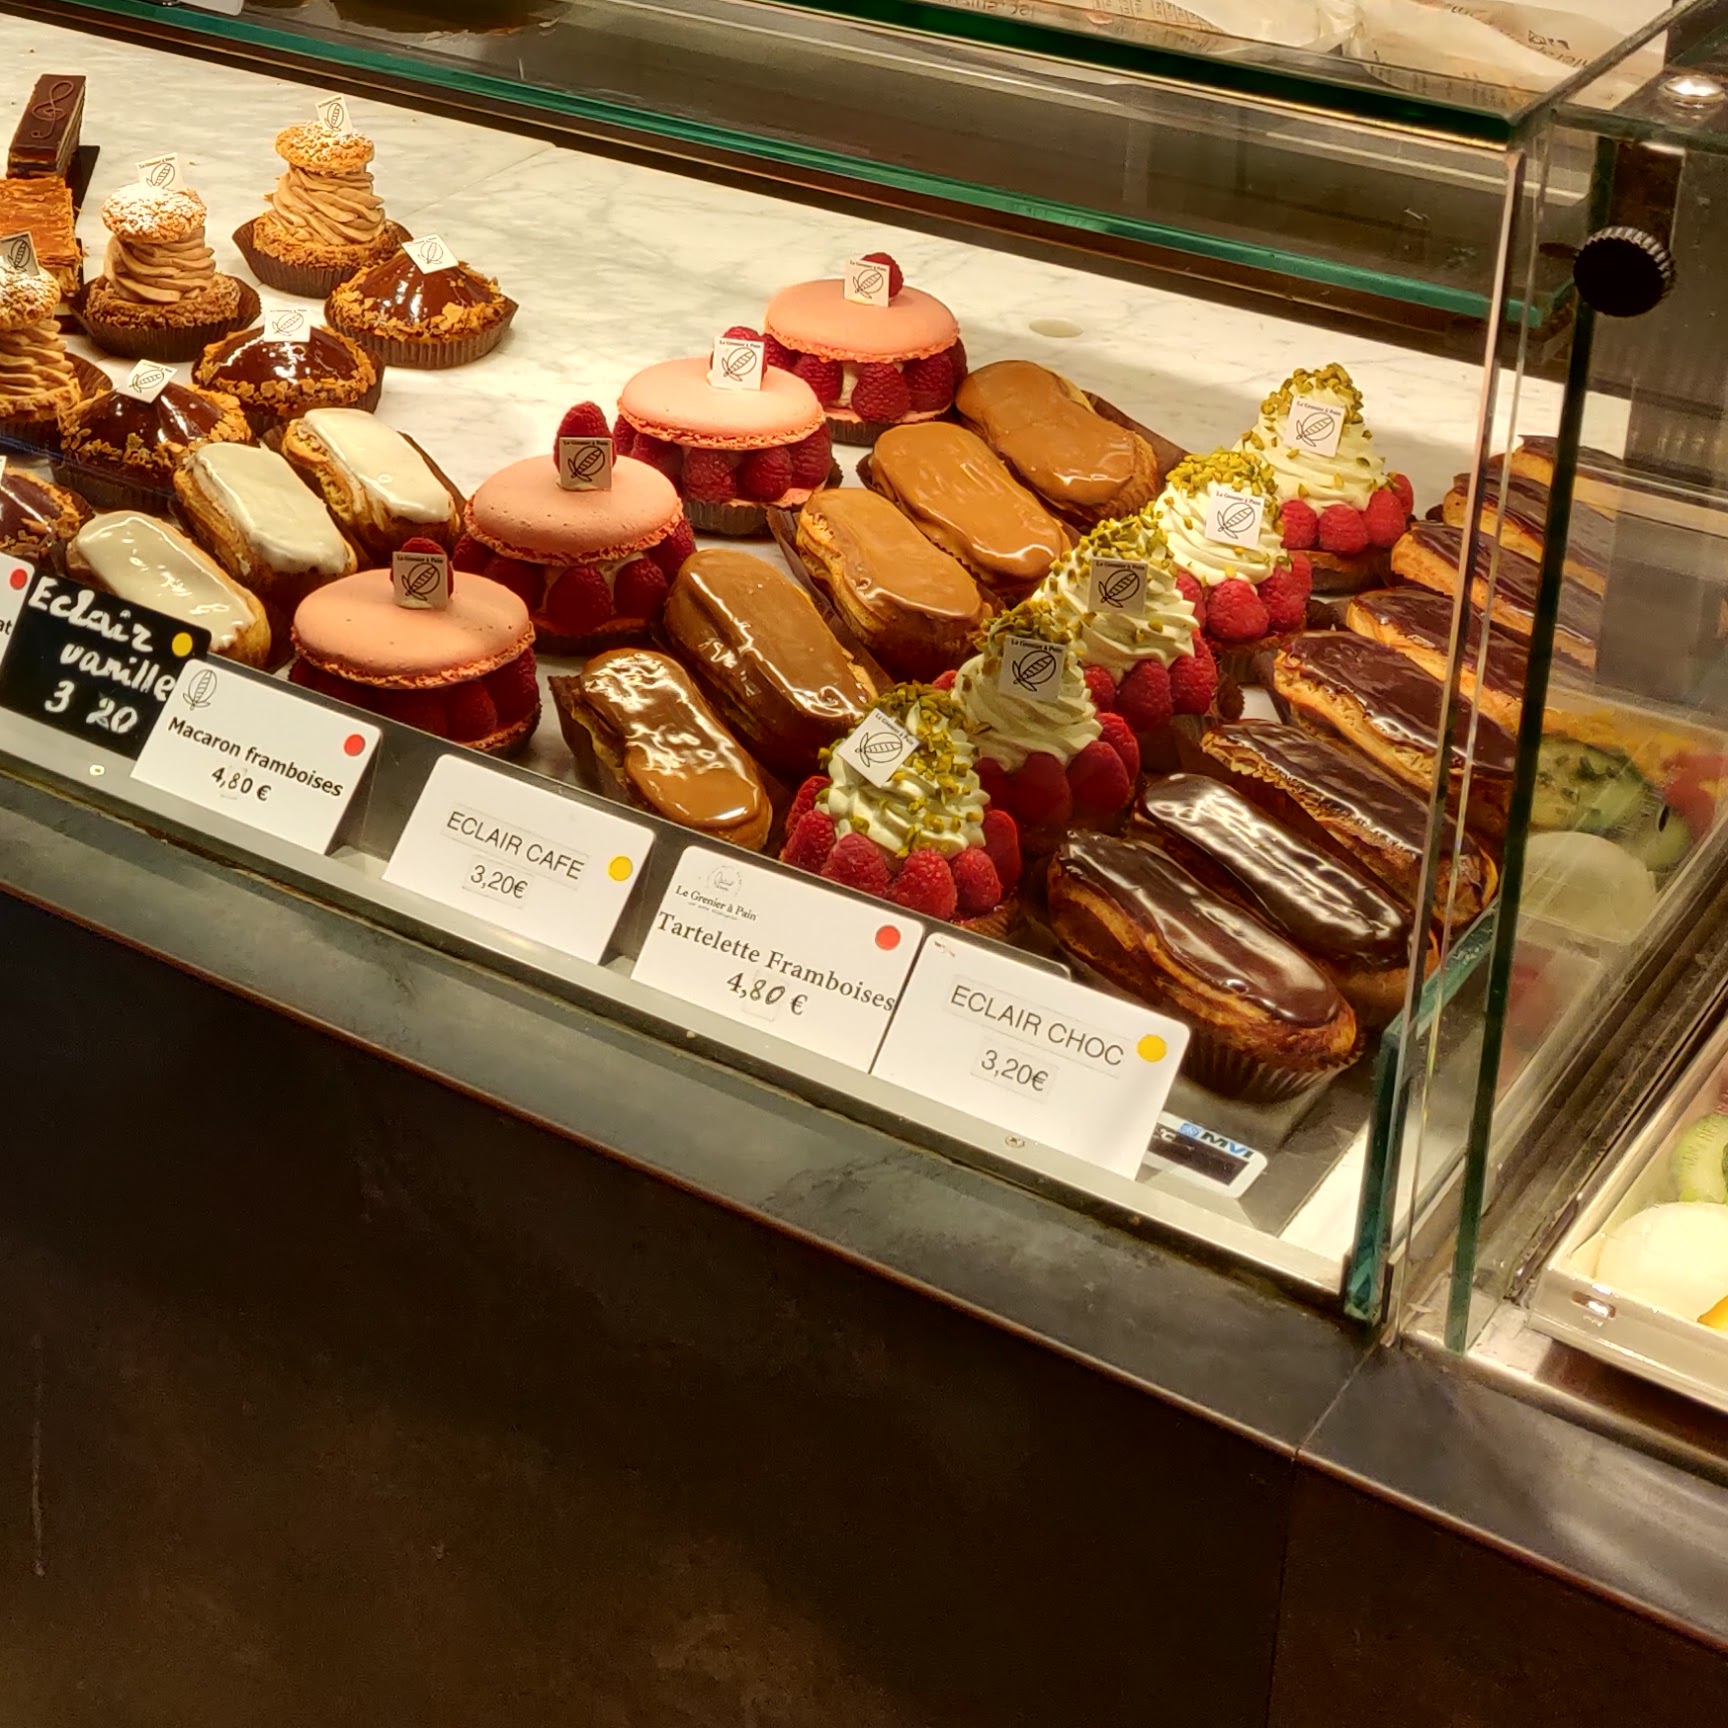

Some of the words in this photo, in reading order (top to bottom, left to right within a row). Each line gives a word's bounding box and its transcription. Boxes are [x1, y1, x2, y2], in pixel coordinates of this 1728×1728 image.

[27, 575, 155, 653] Eclair
[59, 640, 177, 703] vanille
[167, 717, 243, 758] Macaron
[244, 745, 345, 799] framboises
[211, 766, 256, 796] 4,80
[256, 784, 273, 802] €
[446, 811, 525, 858] ECLAIR
[525, 843, 586, 881] CAFE
[468, 864, 530, 900] 3,20€
[675, 885, 688, 897] Le
[690, 890, 726, 910] Grenier
[726, 903, 734, 913] à
[735, 905, 757, 921] Pain
[656, 910, 761, 964] Tartelette
[763, 949, 898, 1014] Framboises
[789, 993, 809, 1016] €
[949, 984, 1042, 1037] ECLAIR
[1047, 1022, 1125, 1068] CHOC
[980, 1048, 1049, 1093] 3,20€
[1201, 1131, 1254, 1158] MVI
